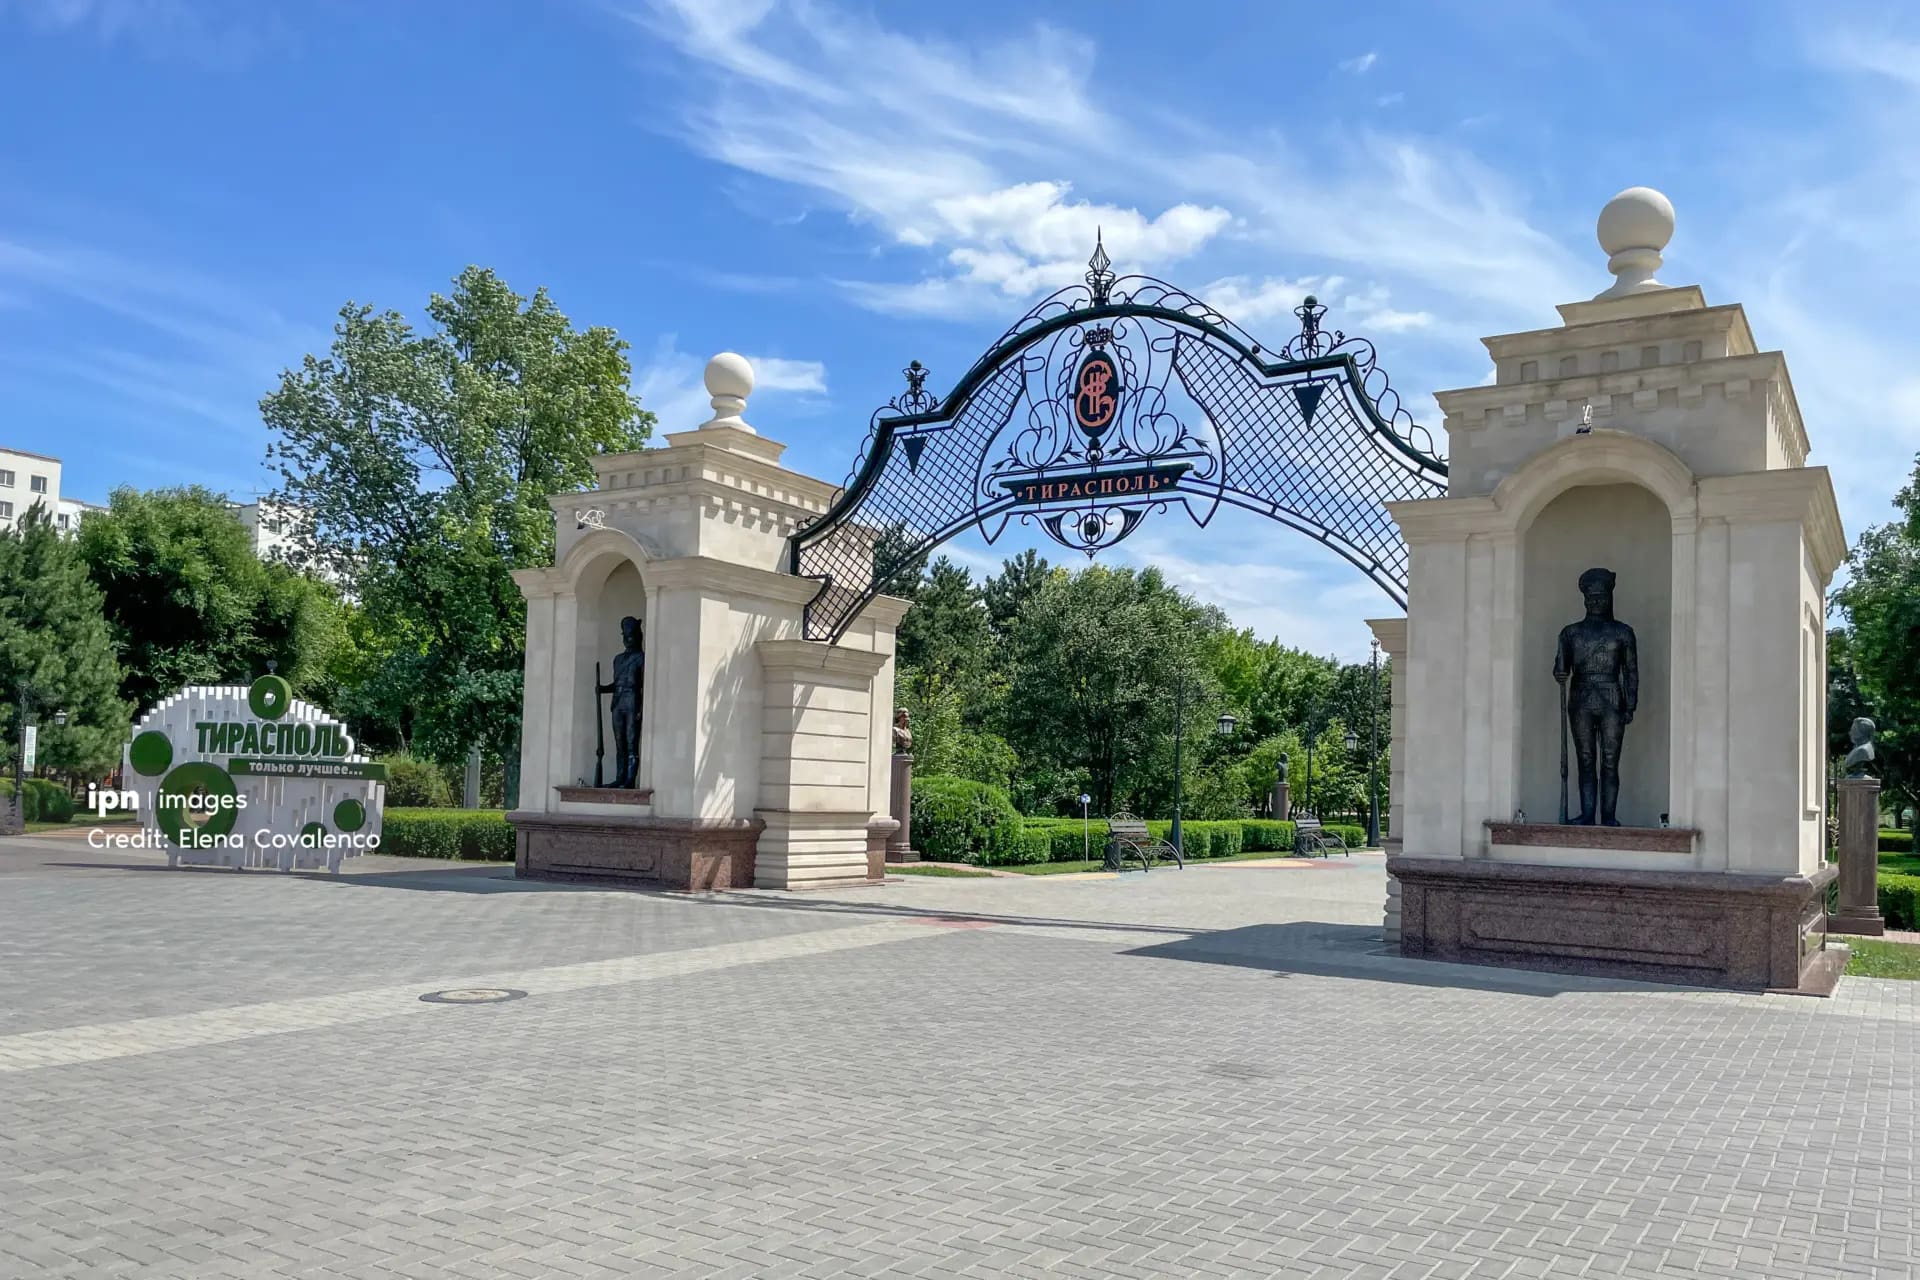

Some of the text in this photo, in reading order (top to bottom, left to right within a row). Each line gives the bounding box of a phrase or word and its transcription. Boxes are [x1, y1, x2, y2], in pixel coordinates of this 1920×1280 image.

[1025, 475, 1160, 500] ТИРАСПОЛЬ
[194, 721, 352, 757] ТИРАСПОЛЬ
[249, 761, 295, 773] только
